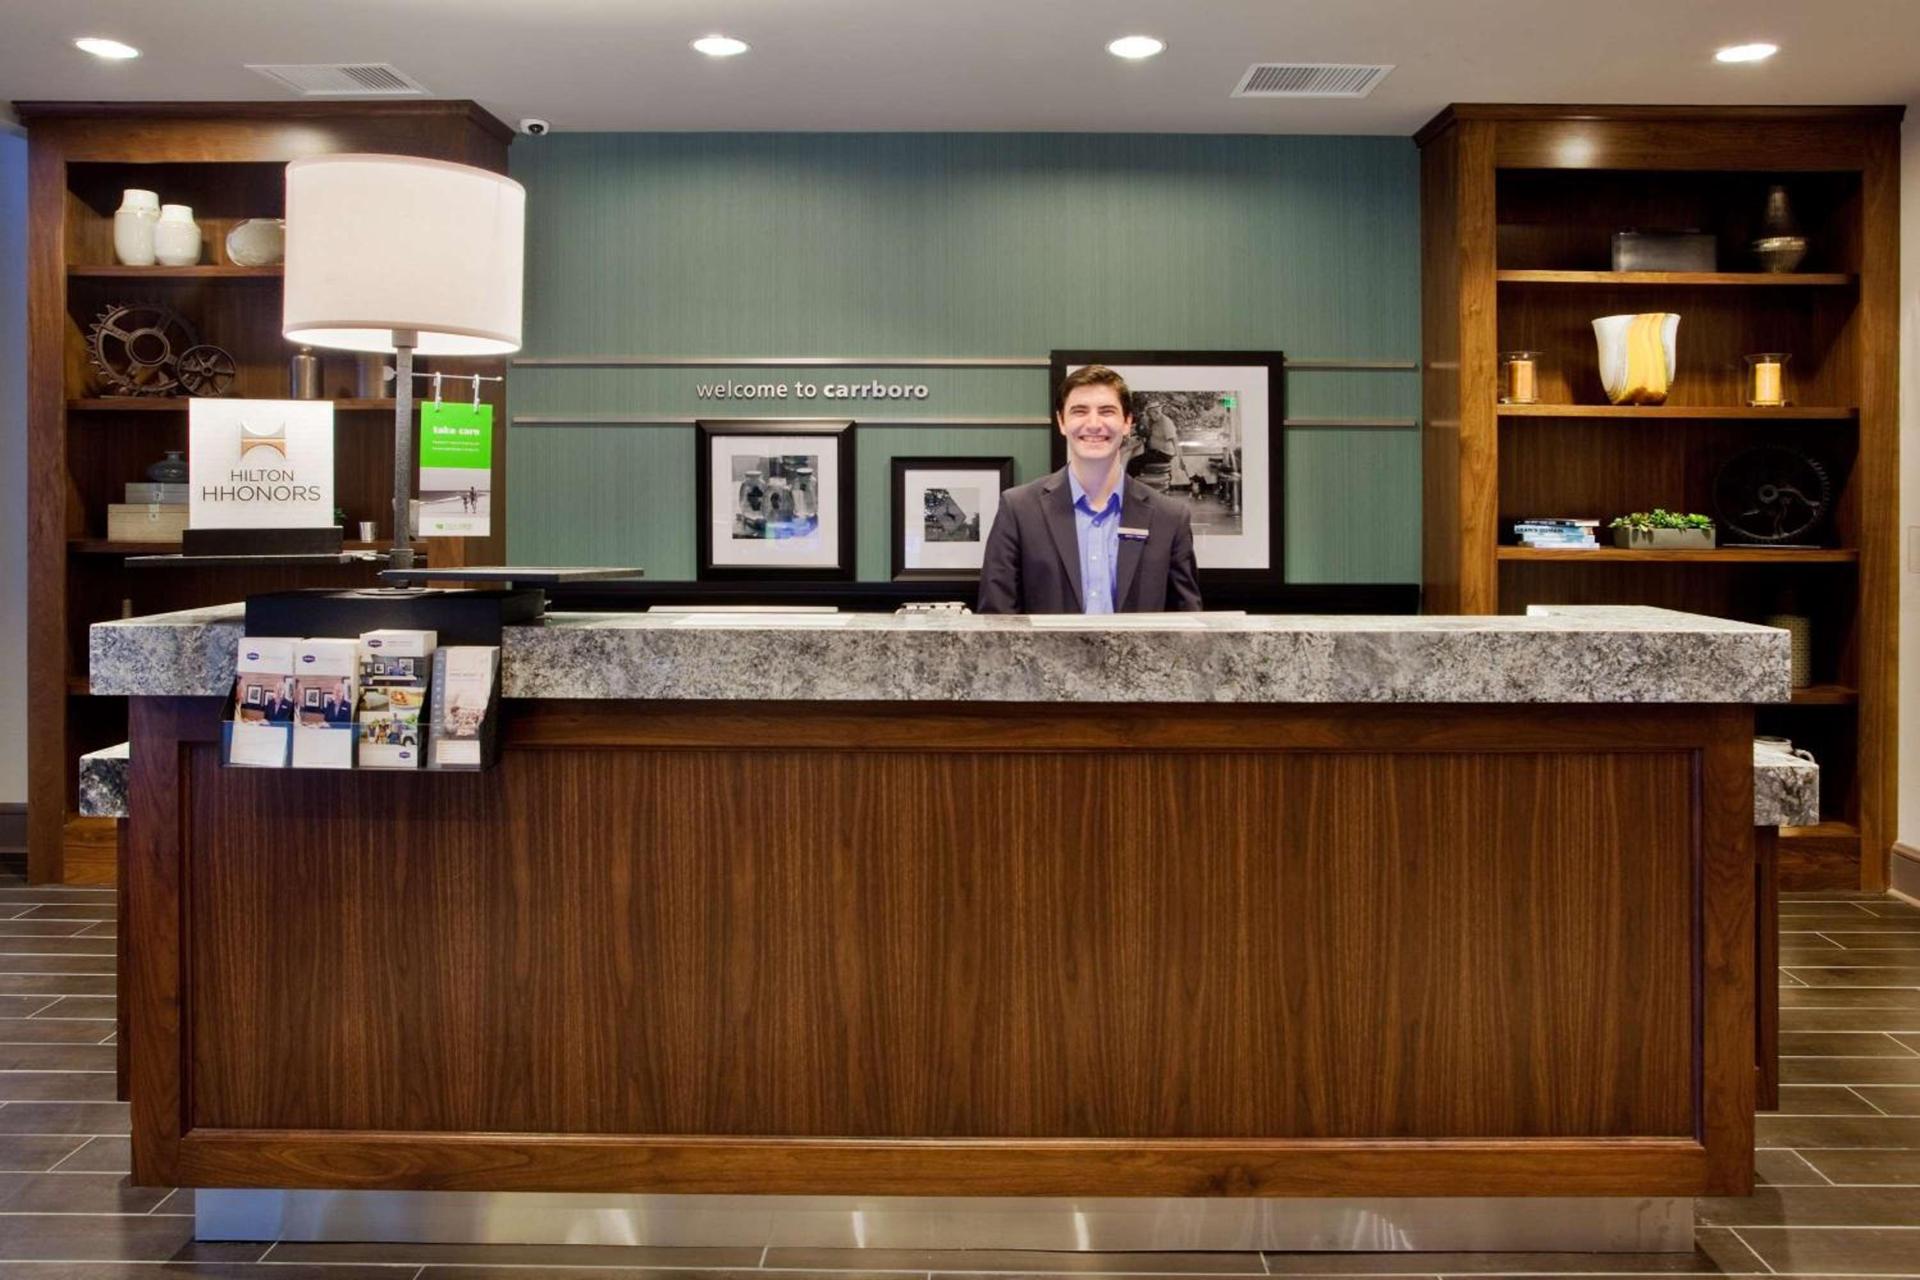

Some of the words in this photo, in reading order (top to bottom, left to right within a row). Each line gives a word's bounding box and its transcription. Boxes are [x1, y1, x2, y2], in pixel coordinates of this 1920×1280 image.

[696, 380, 788, 398] welcome
[795, 381, 817, 398] to
[823, 380, 929, 398] carrboro
[432, 425, 456, 435] take
[458, 427, 480, 436] care
[231, 469, 294, 482] HILTON
[202, 485, 321, 502] HHONORS
